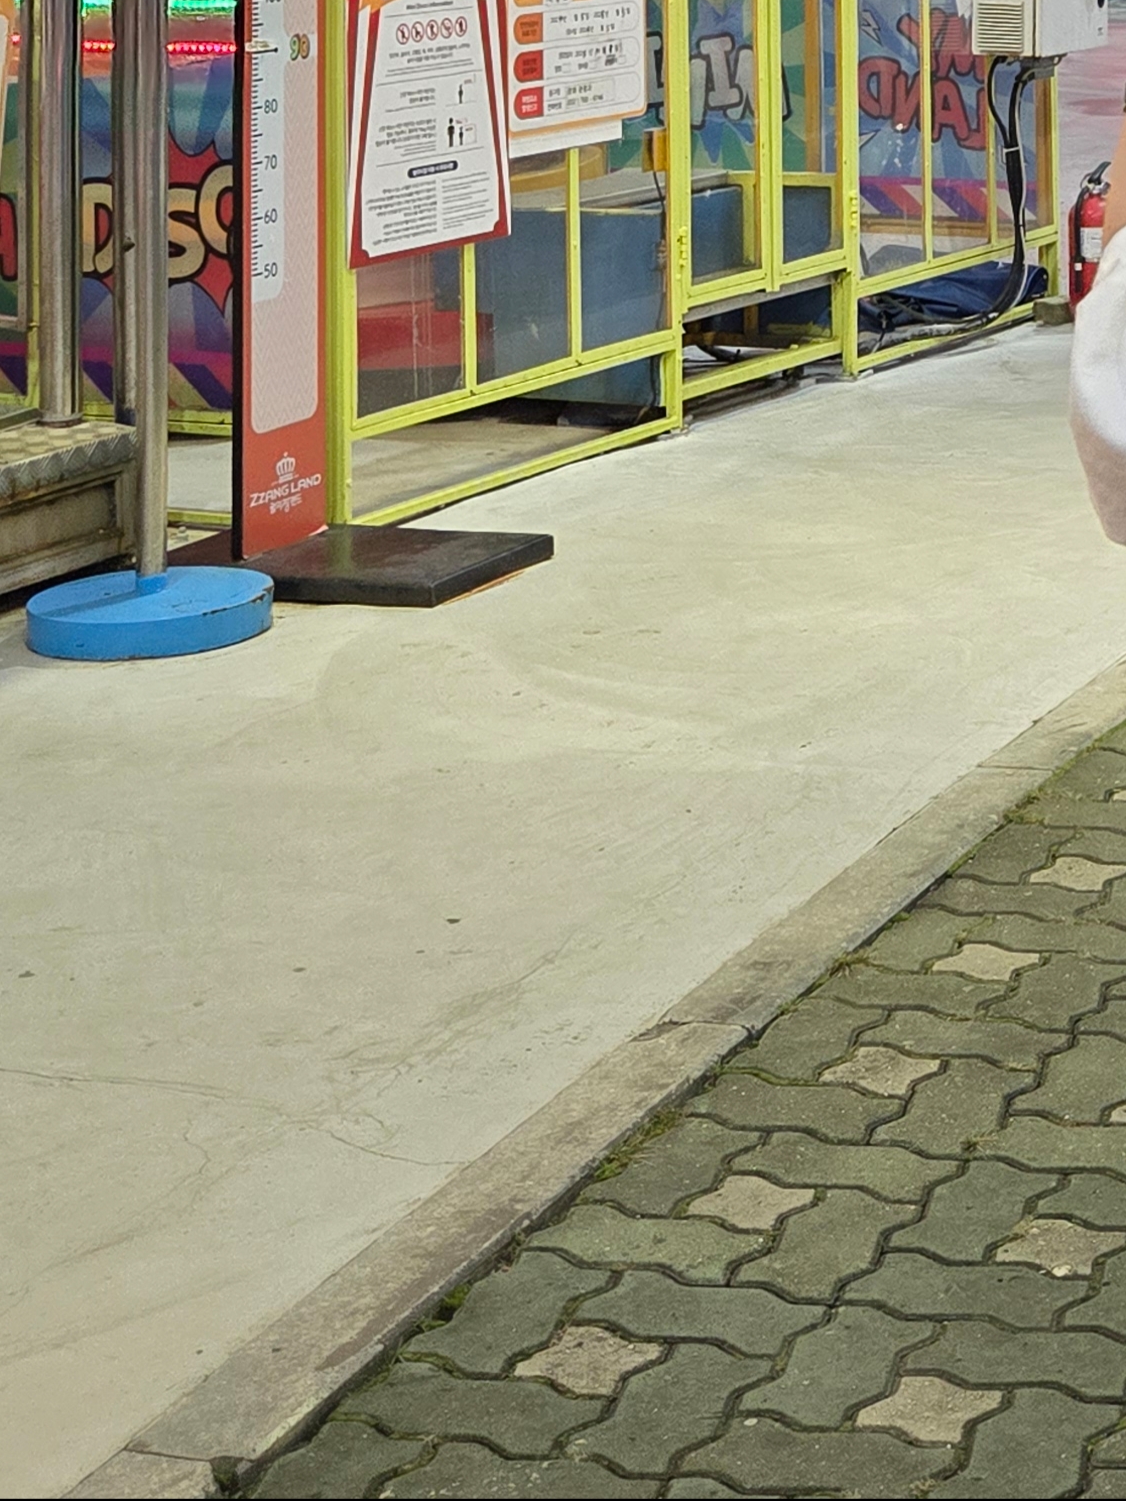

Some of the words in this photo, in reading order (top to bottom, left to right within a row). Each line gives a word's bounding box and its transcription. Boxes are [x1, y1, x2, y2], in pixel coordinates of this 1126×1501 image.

[289, 33, 311, 61] 90
[264, 99, 279, 114] 80
[264, 154, 278, 170] 70
[264, 208, 279, 224] 60
[264, 262, 279, 279] 50
[249, 483, 290, 509] ZZANG
[290, 473, 322, 494] LAND
